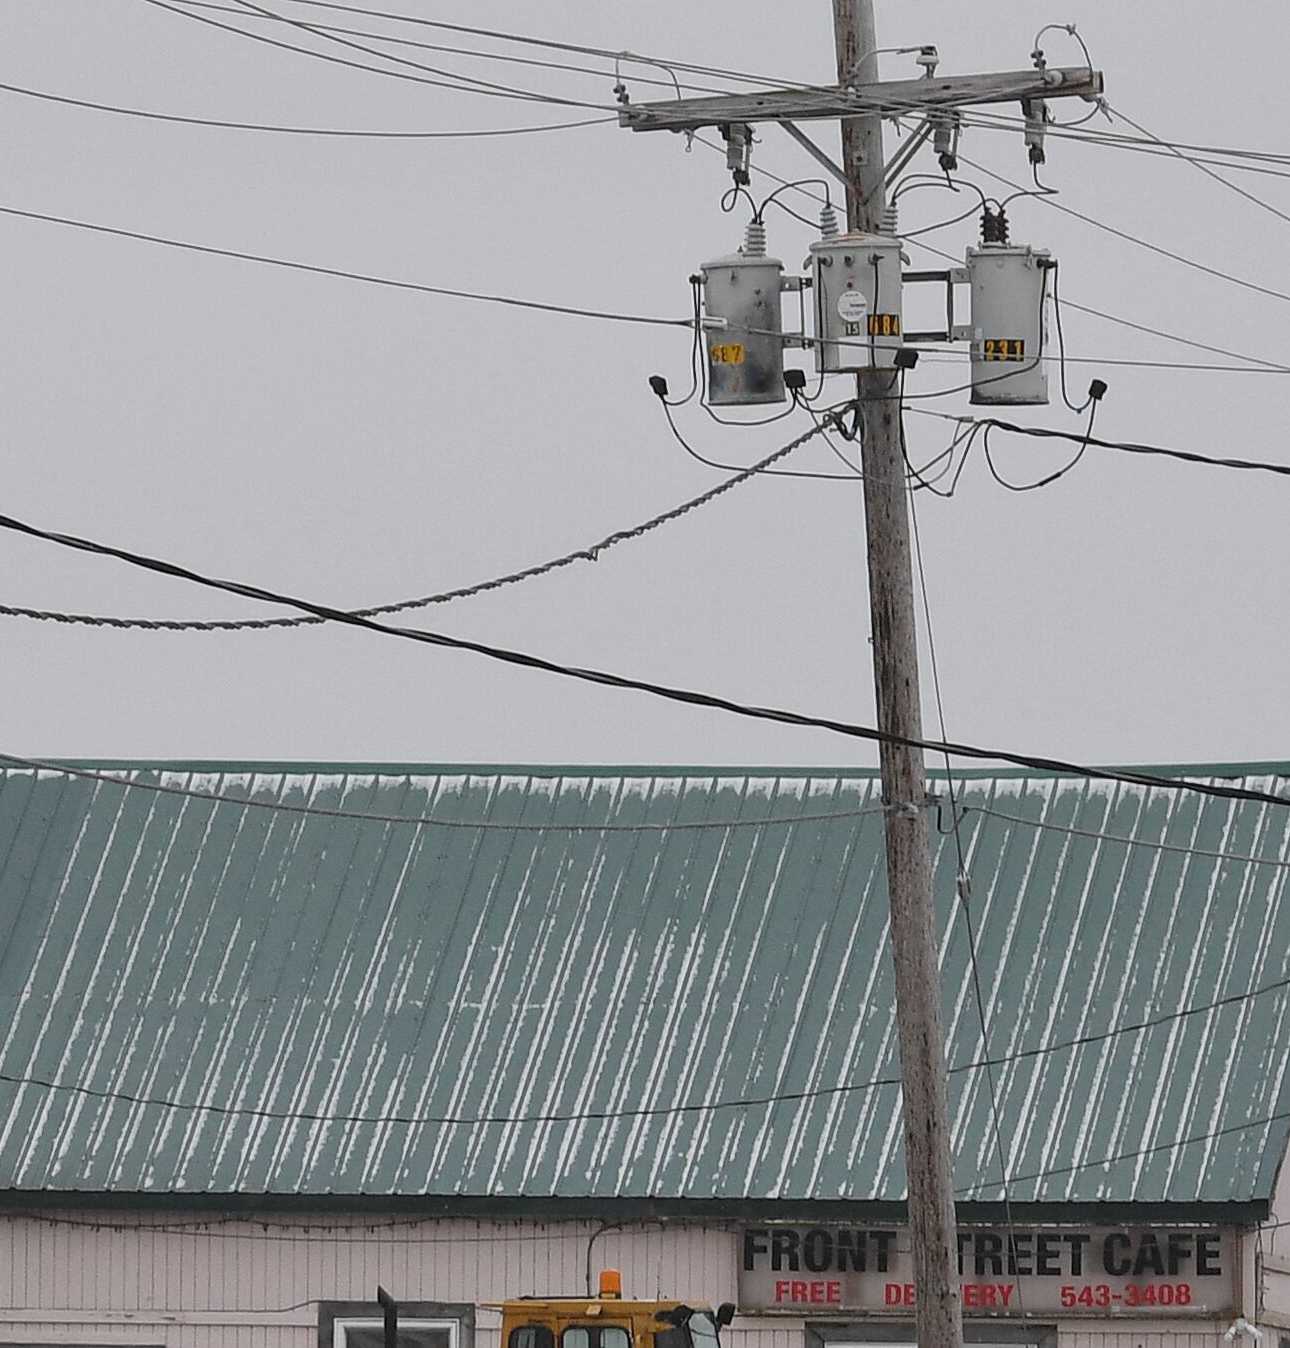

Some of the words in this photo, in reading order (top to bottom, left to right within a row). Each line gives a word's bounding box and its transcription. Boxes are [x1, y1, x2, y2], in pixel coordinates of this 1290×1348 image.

[986, 340, 1022, 361] 231
[743, 1228, 897, 1273] FRONT
[956, 1232, 1091, 1276] TREET
[1102, 1232, 1223, 1277] CAFE
[774, 1280, 842, 1304] FREE
[884, 1283, 1014, 1307] DEERY
[1060, 1283, 1192, 1307] 543-3408
